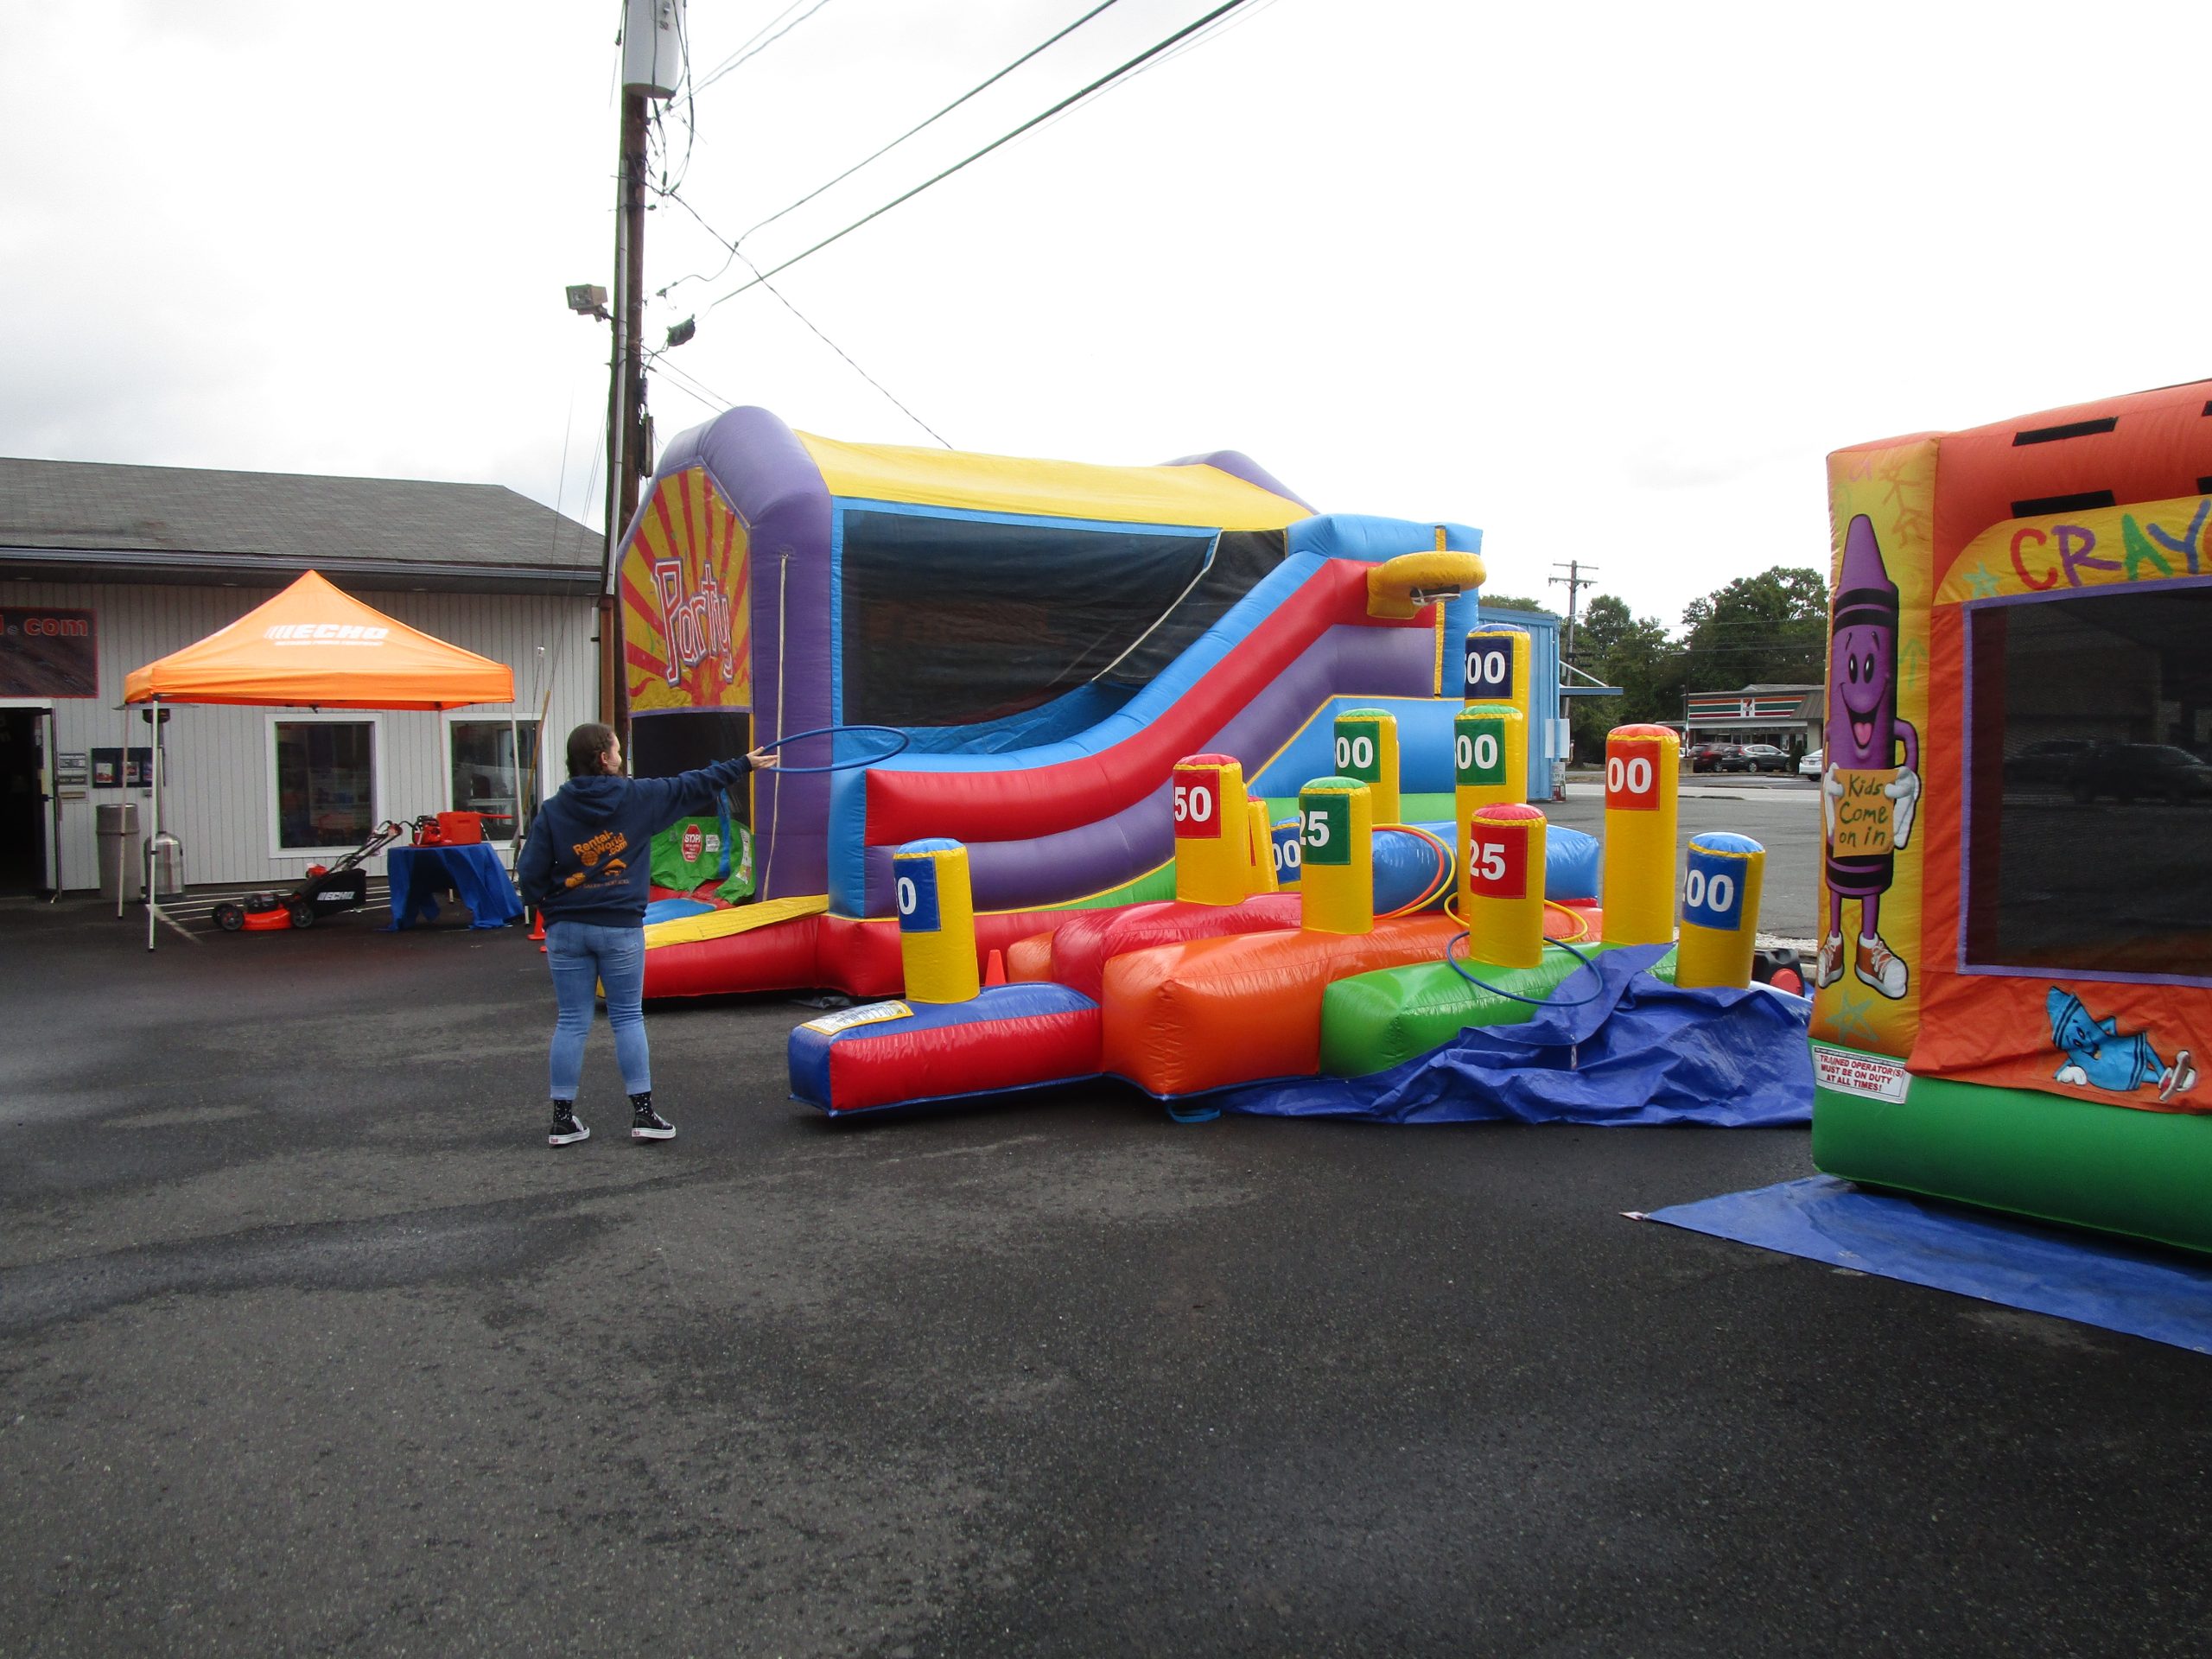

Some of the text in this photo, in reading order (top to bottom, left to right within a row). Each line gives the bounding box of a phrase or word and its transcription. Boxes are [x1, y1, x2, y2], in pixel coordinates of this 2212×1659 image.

[2010, 499, 2212, 591] CRAY
[0, 614, 88, 637] .com
[291, 624, 389, 639] ECHO
[654, 557, 733, 687] Party
[1465, 652, 1506, 684] 00
[1335, 736, 1374, 768] 00
[1455, 734, 1498, 769] 00
[1607, 757, 1652, 794] 00
[1848, 773, 1884, 797] Kids
[1173, 786, 1212, 822] 50
[1840, 801, 1889, 824] Come
[572, 830, 613, 855] Rental-
[594, 832, 625, 855] World
[608, 841, 627, 856] .com
[1839, 826, 1886, 848] on in
[1470, 838, 1506, 880] 25
[325, 891, 355, 901] ECHO
[893, 876, 917, 914] 0
[1683, 866, 1734, 912] 00
[1820, 1054, 1850, 1068] TRAINED
[1851, 1060, 1904, 1079] OPERATOR(S)
[1821, 1064, 1893, 1084] MUST BE ON DUTY
[1837, 1077, 1851, 1086] ALL
[1853, 1079, 1882, 1091] TIMES!
